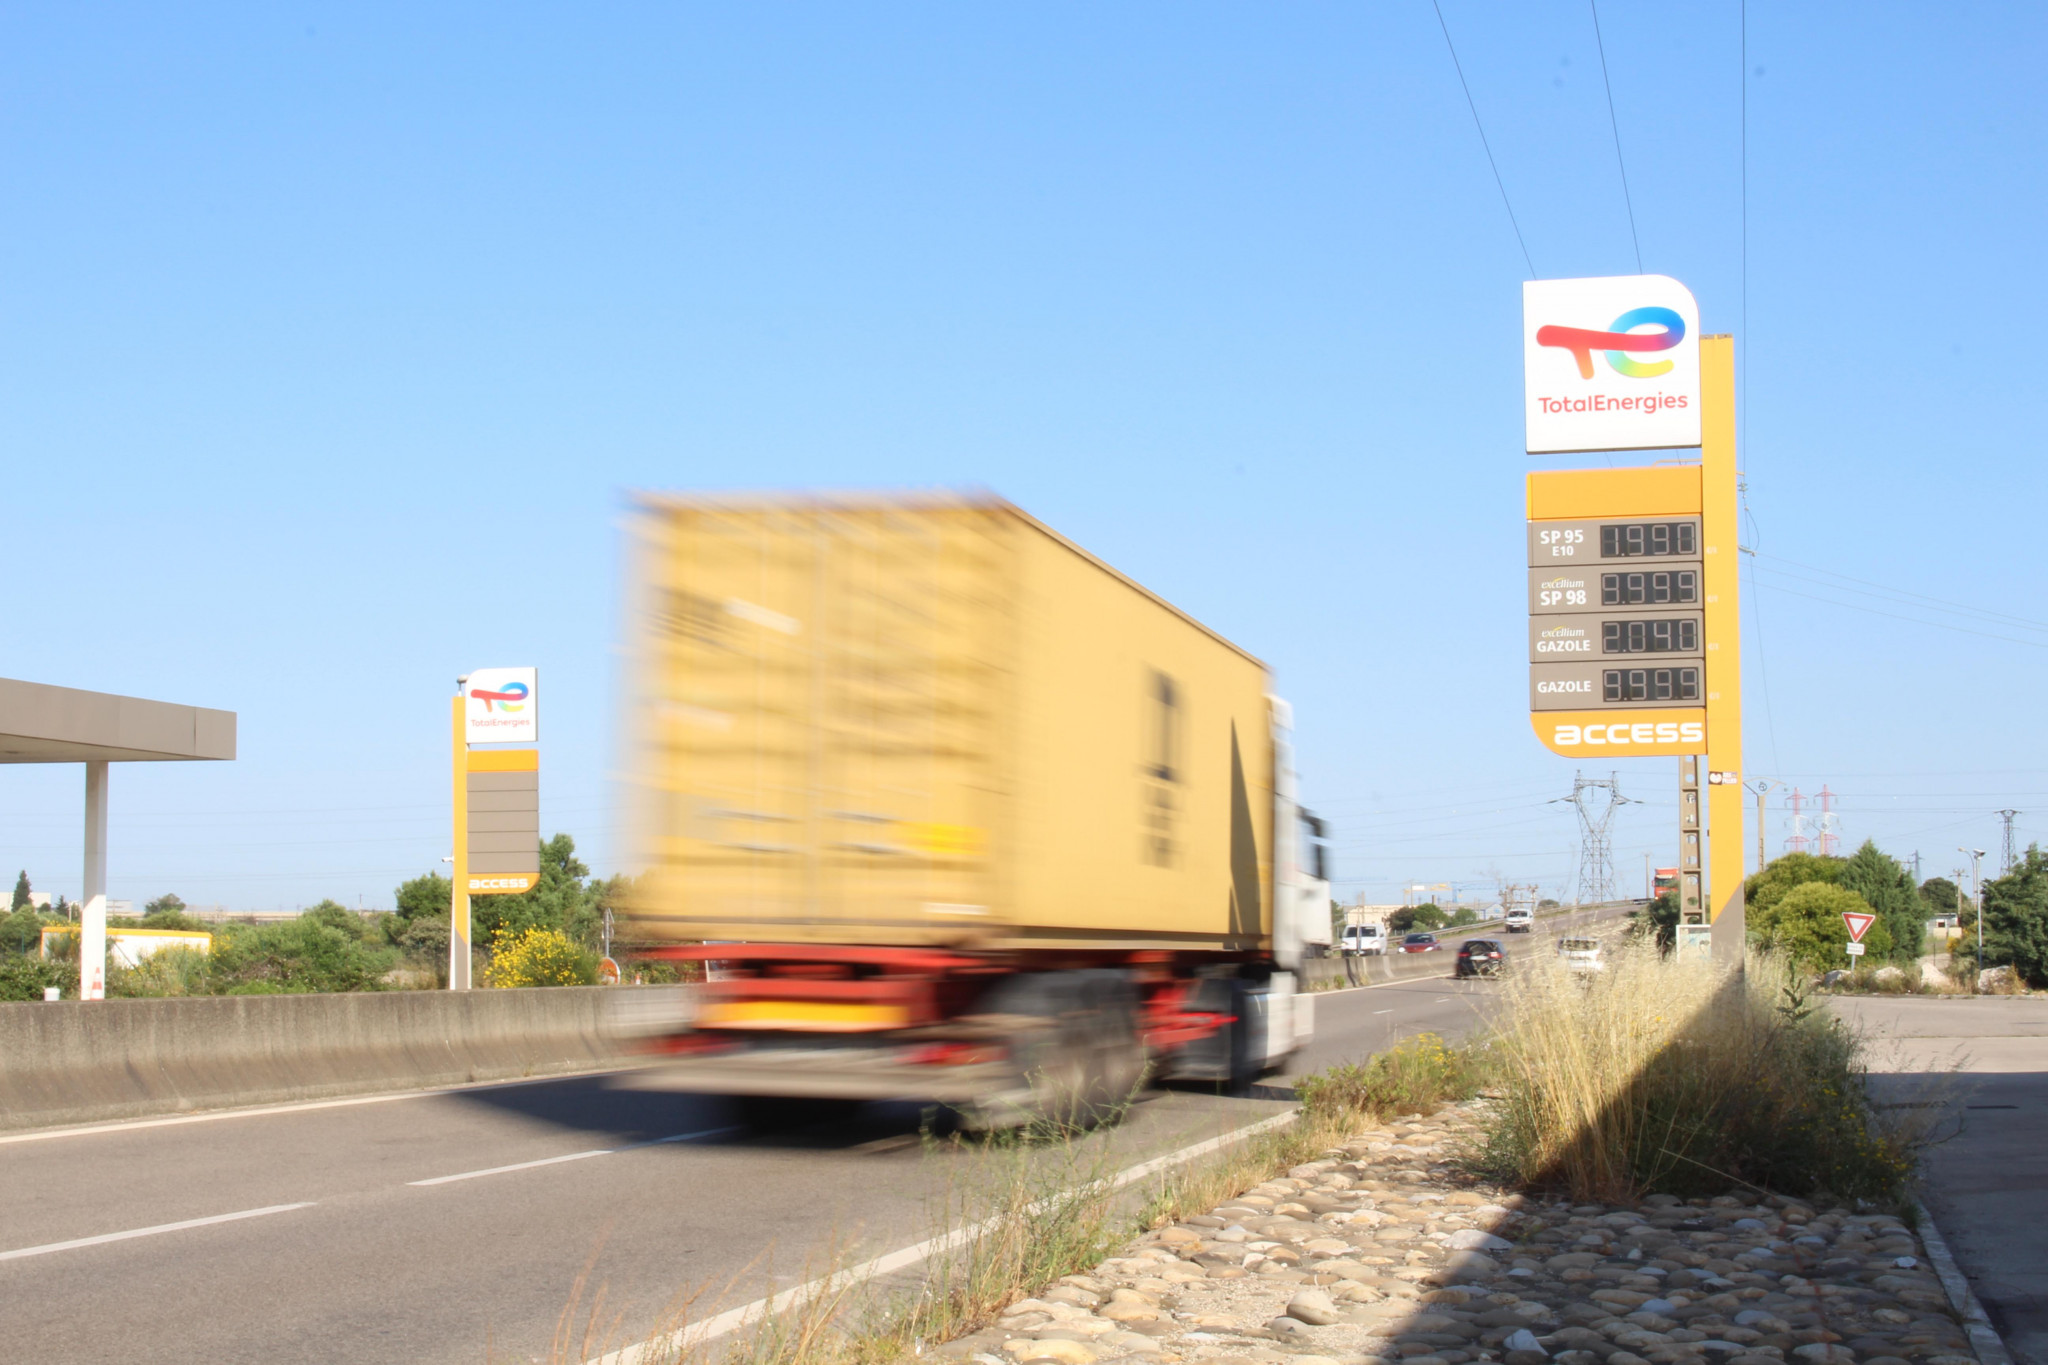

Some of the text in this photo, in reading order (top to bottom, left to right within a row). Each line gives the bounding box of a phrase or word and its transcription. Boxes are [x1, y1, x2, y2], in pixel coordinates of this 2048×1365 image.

[1538, 391, 1688, 414] TotalEnergies
[1540, 529, 1584, 545] SP 95
[1552, 545, 1574, 557] E10
[1541, 578, 1584, 589] excellium
[1540, 590, 1587, 606] SP 98
[1541, 627, 1585, 638] excellium
[1536, 639, 1591, 653] GAZOLE
[1537, 680, 1592, 693] GAZOLE
[470, 718, 530, 728] TotalEnergies
